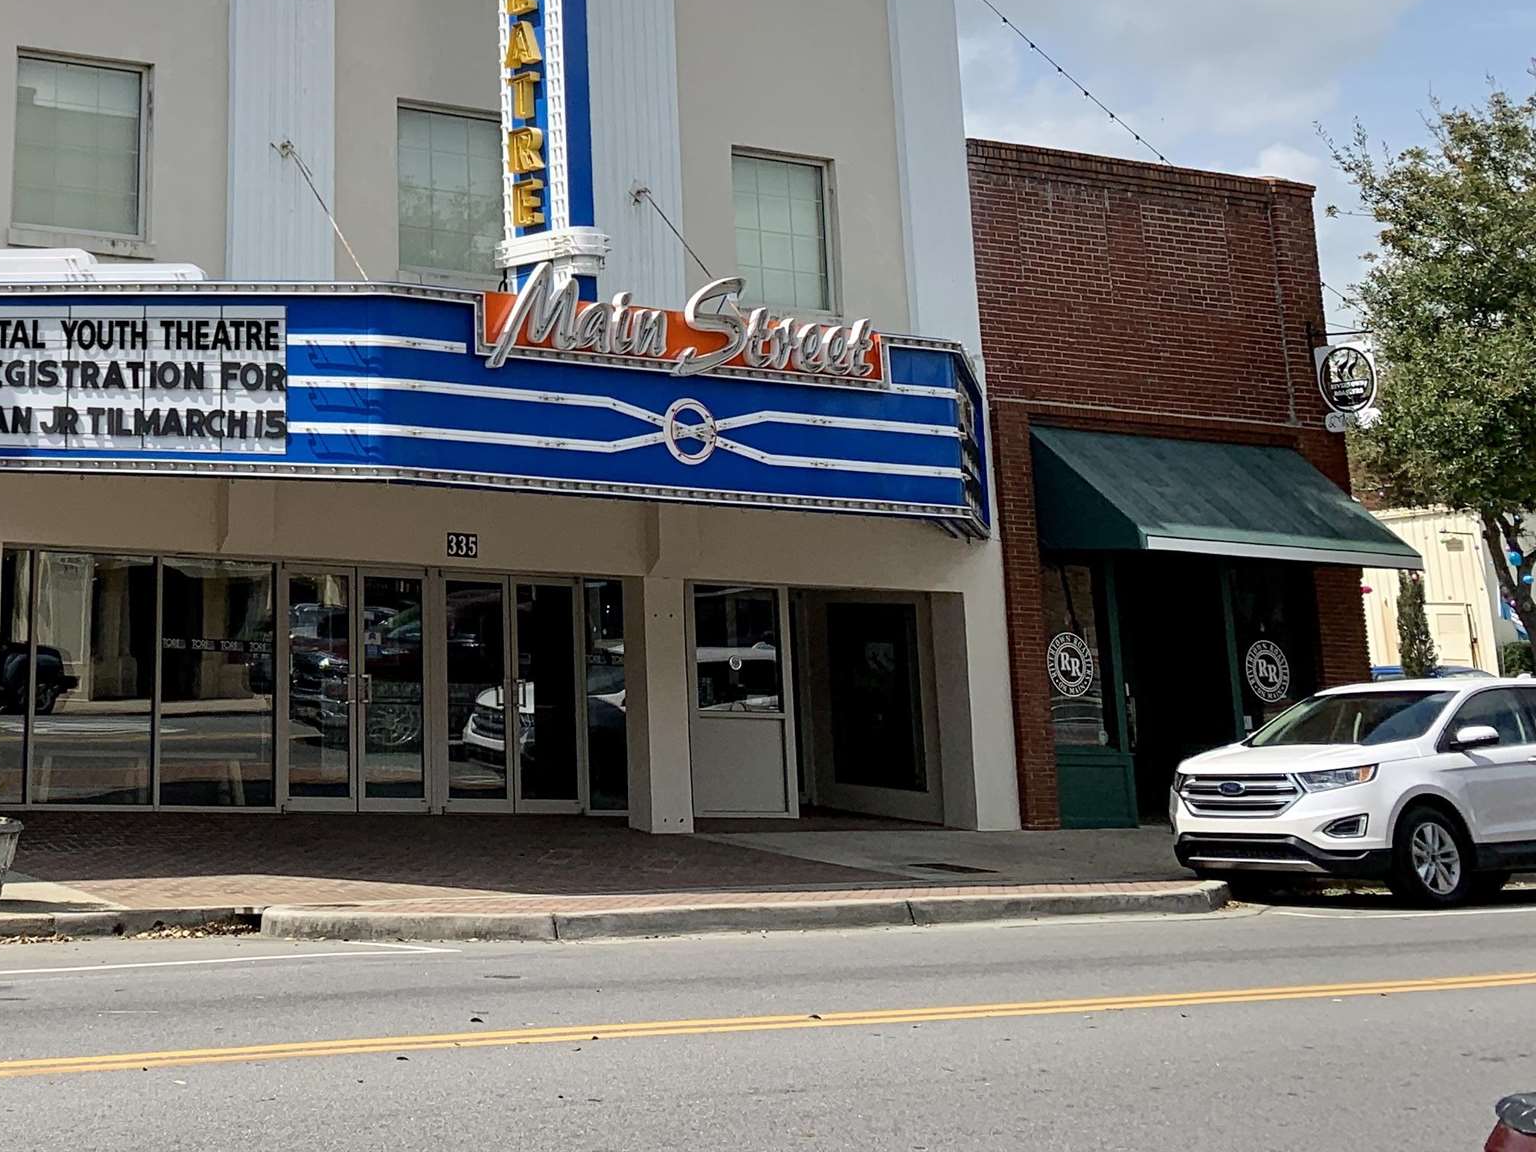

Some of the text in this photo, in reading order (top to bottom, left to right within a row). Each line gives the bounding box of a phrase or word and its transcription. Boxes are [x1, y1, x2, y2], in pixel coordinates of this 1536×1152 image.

[485, 261, 873, 377] Main Street
[61, 319, 148, 351] YOUTH
[159, 320, 280, 352] THEATRE
[221, 362, 287, 391] FOR
[40, 406, 79, 435] JR
[448, 534, 476, 556] 335
[1060, 651, 1083, 677] RR
[1258, 658, 1279, 683] RR
